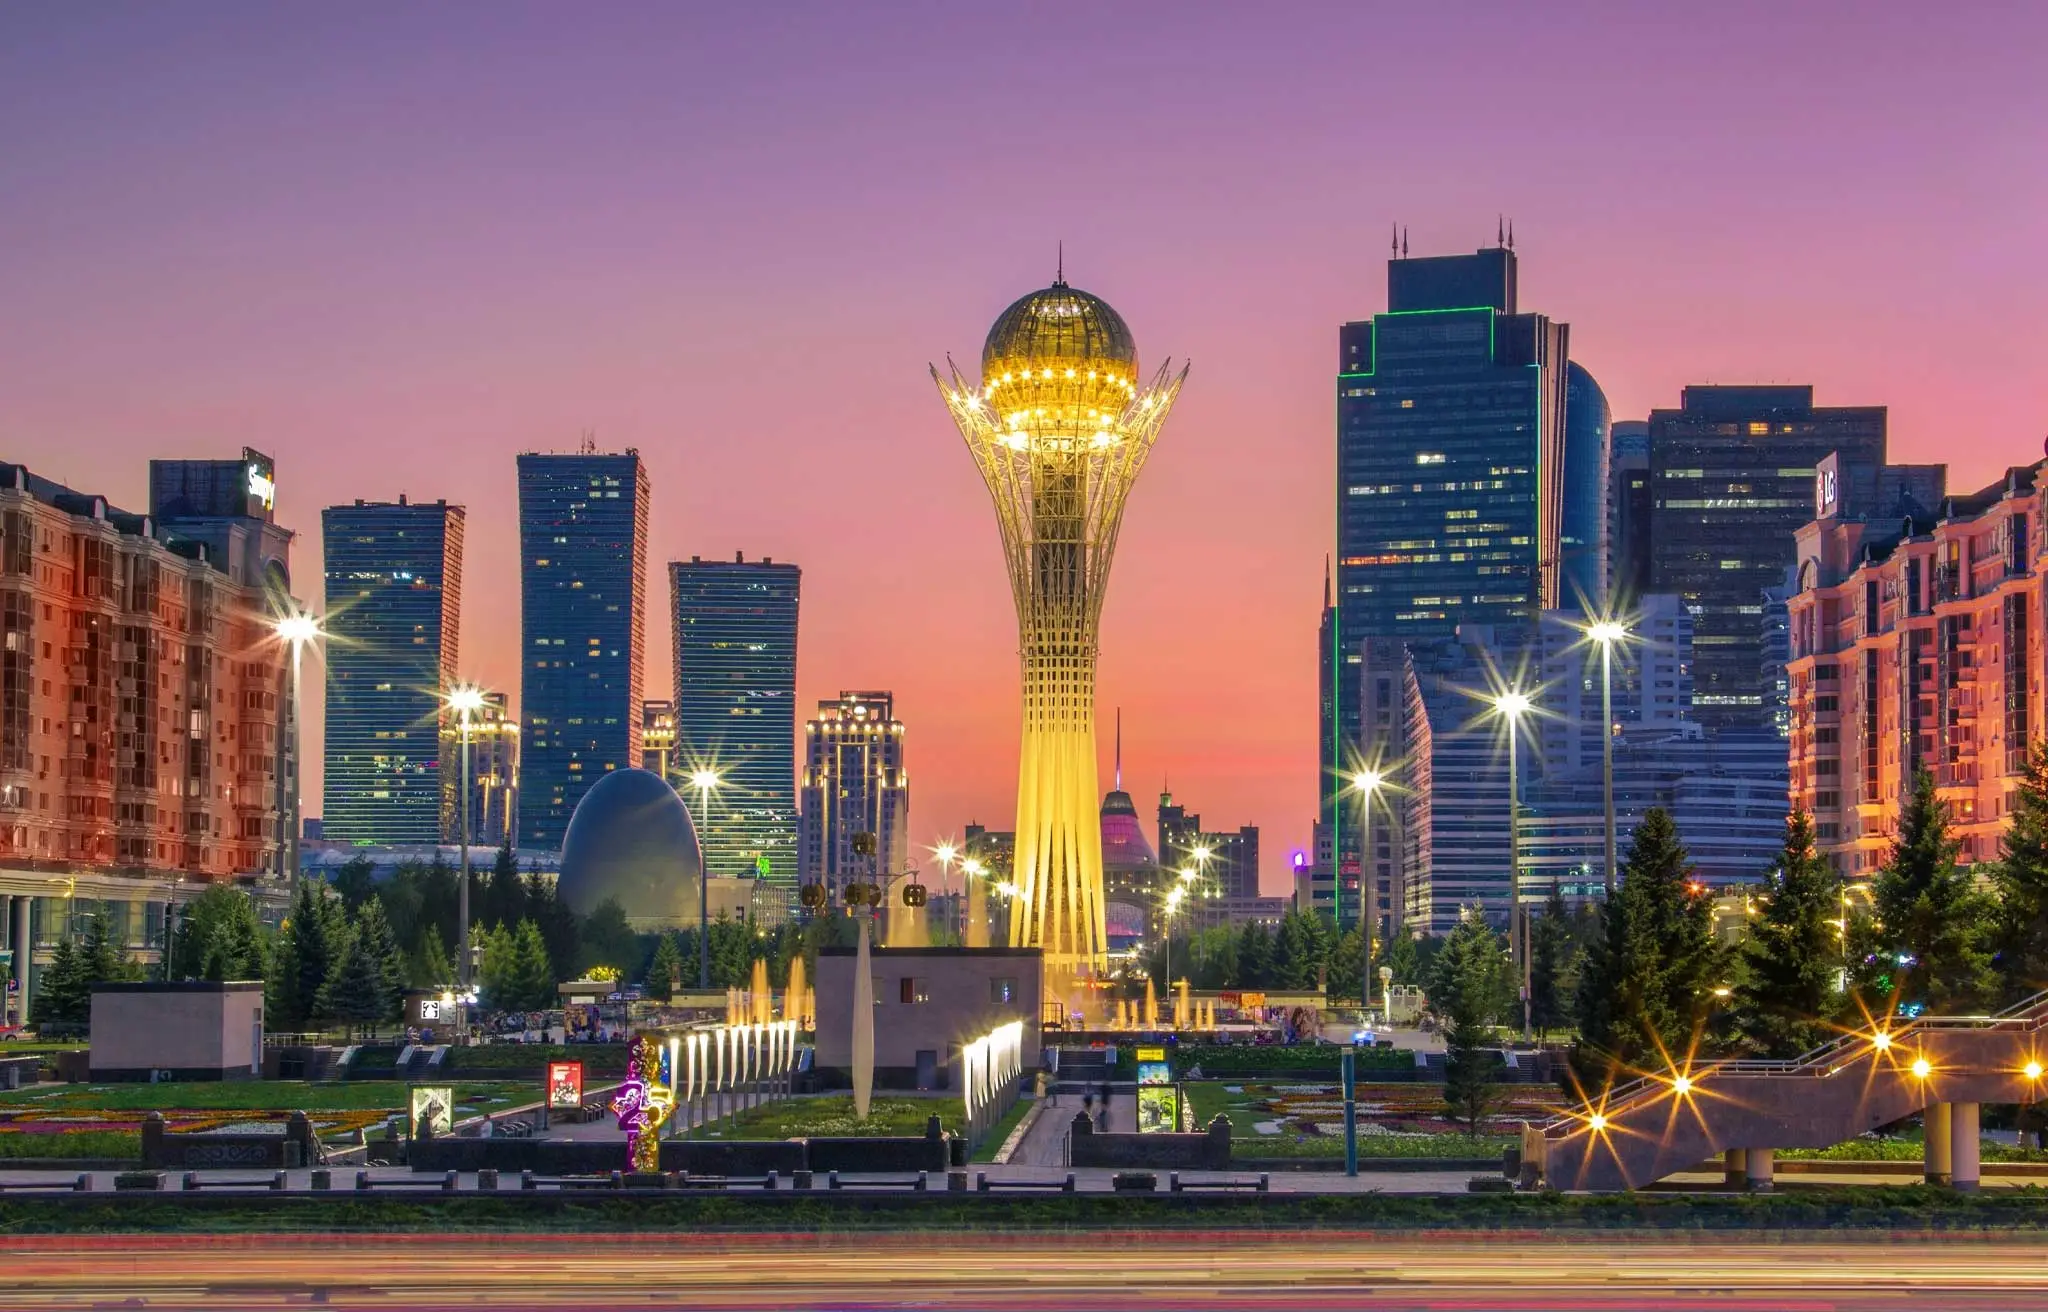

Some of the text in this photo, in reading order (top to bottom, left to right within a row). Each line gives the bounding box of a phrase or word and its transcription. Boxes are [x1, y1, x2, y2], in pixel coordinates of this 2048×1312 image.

[1825, 471, 1834, 504] LG
[9, 980, 17, 990] P
[616, 1080, 673, 1132] 25
